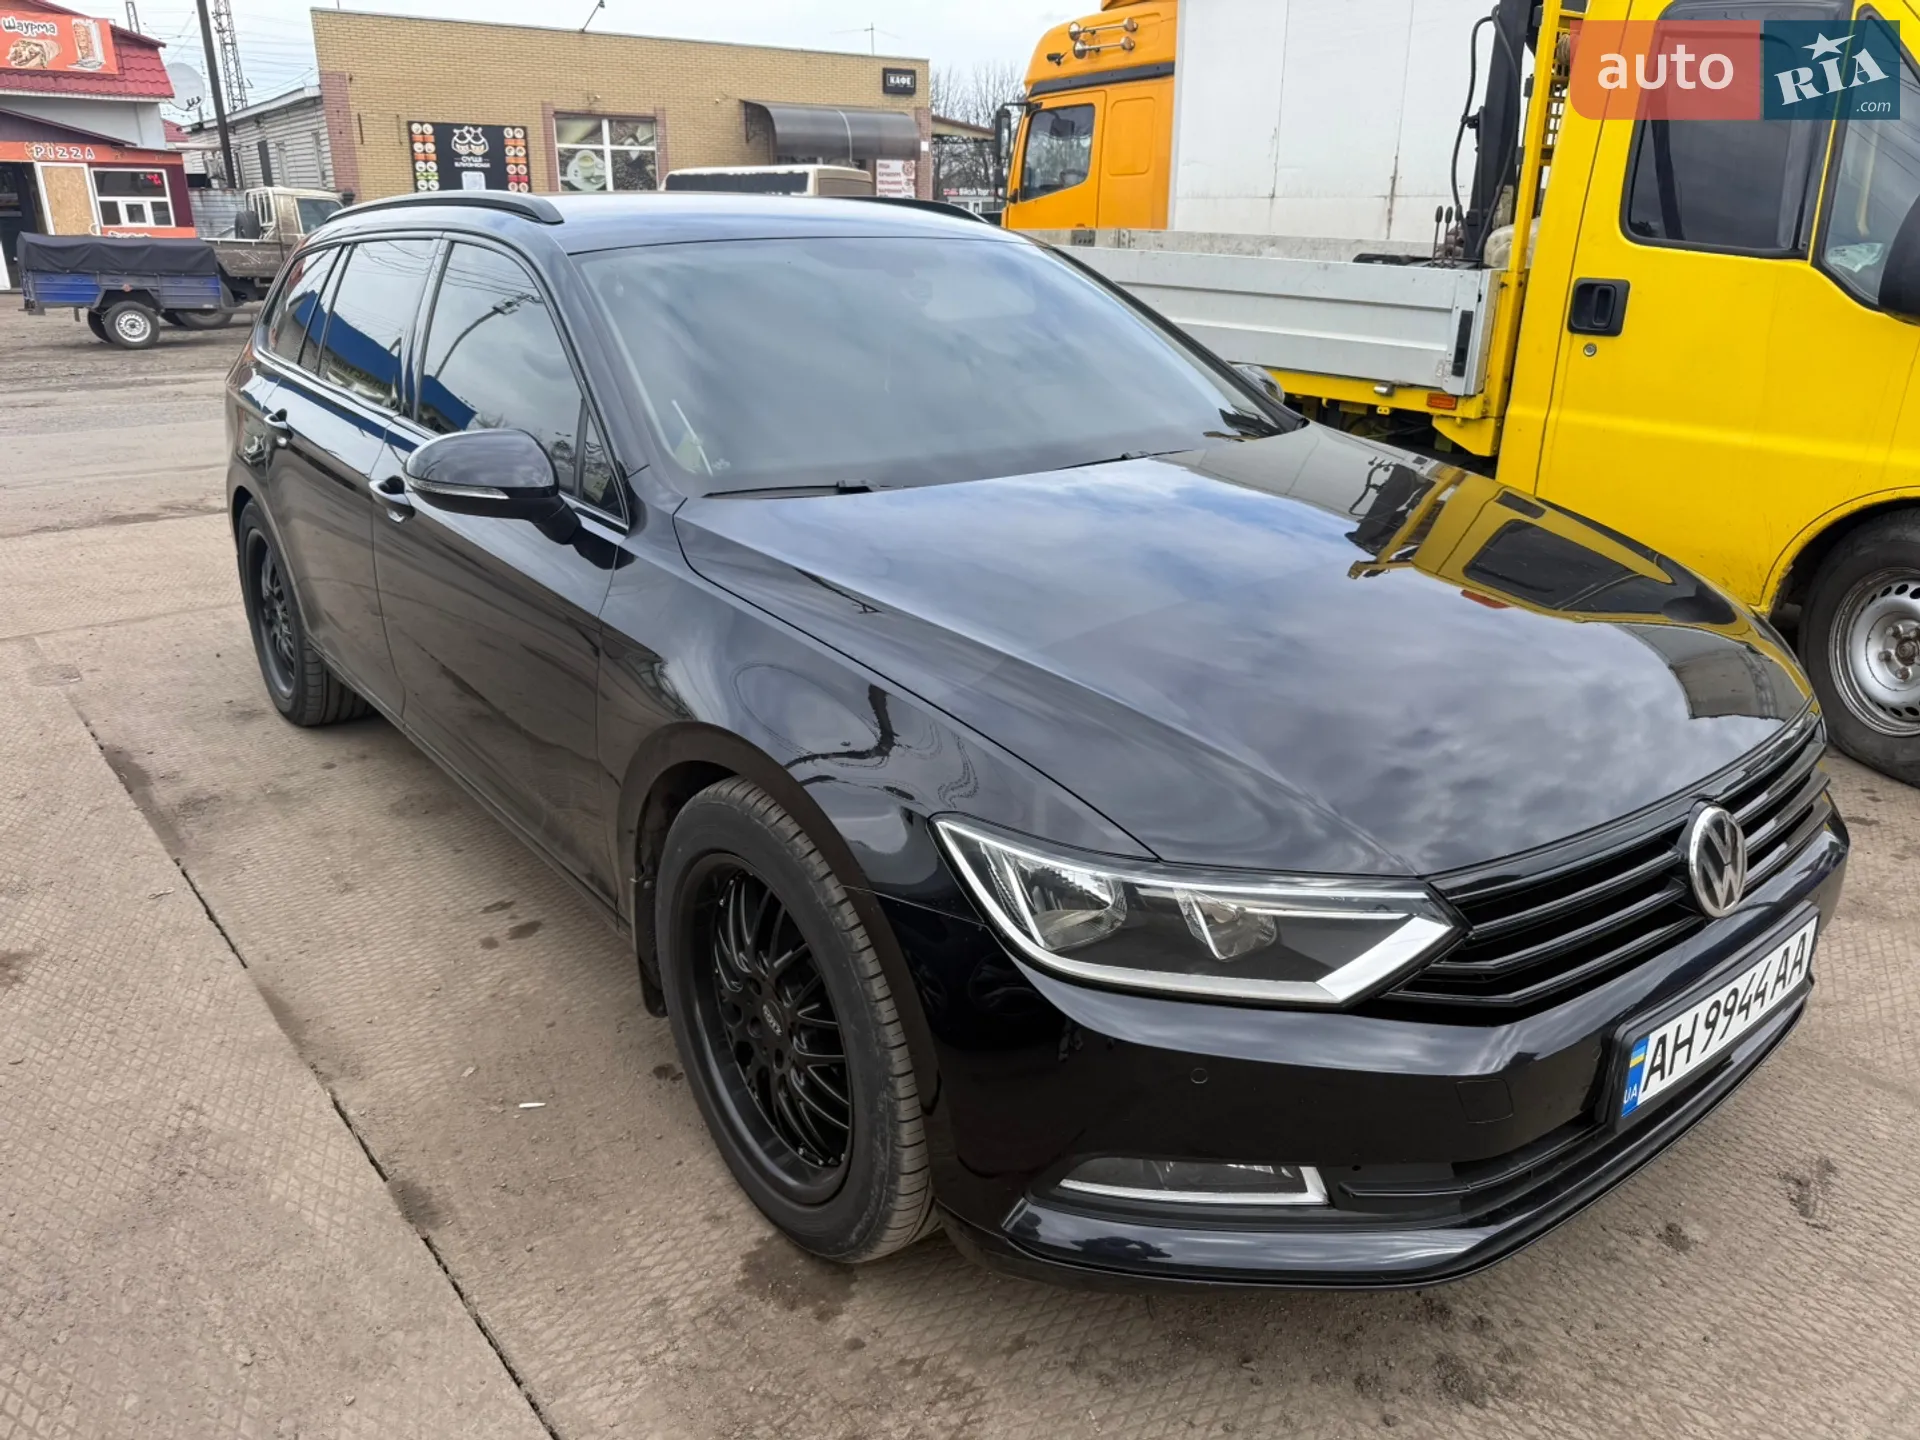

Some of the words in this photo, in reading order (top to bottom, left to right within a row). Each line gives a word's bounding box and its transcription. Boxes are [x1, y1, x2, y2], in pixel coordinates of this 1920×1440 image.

[2, 17, 56, 35] Шаурма
[889, 76, 911, 85] КАФЕ
[34, 145, 95, 160] PIZZA
[1642, 1013, 1699, 1093] AH
[1700, 960, 1772, 1054] 9944
[1770, 932, 1807, 1000] AA
[1624, 1085, 1639, 1104] UA
